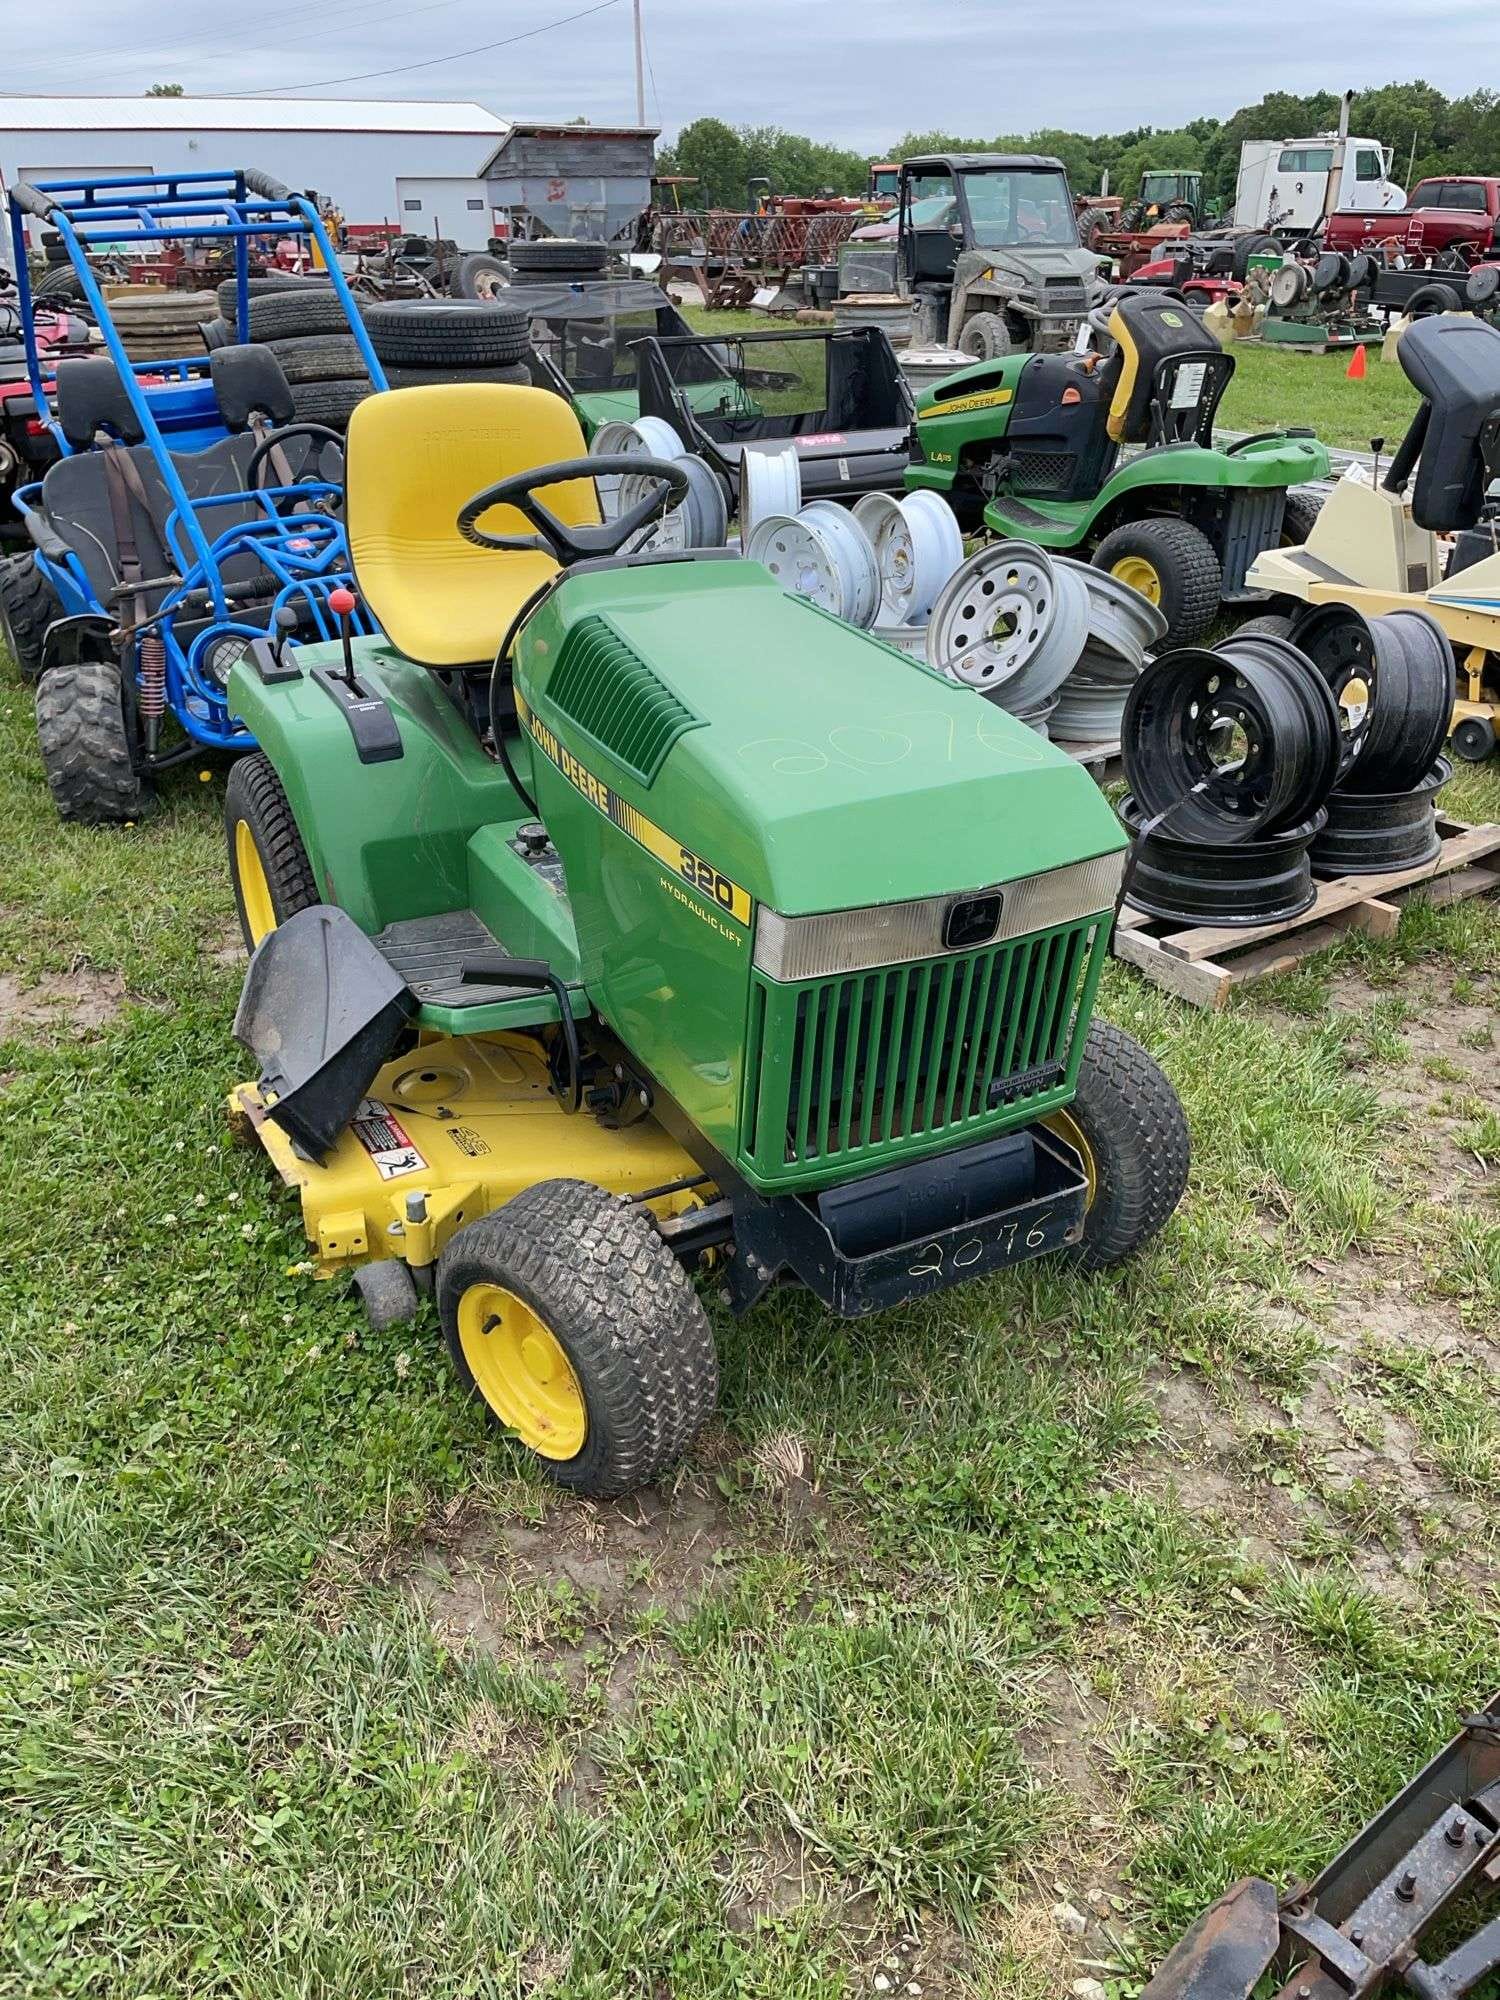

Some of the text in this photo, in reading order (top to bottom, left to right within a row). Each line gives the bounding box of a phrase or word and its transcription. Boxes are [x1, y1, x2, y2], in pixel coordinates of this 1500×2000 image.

[948, 398, 996, 412] JOHN DEERE
[530, 714, 609, 815] JOHN DEERE
[736, 710, 1044, 775] 2076
[679, 848, 734, 911] 320
[660, 877, 742, 947] HYDRAULIC LIFT
[908, 1212, 1053, 1276] 2076
